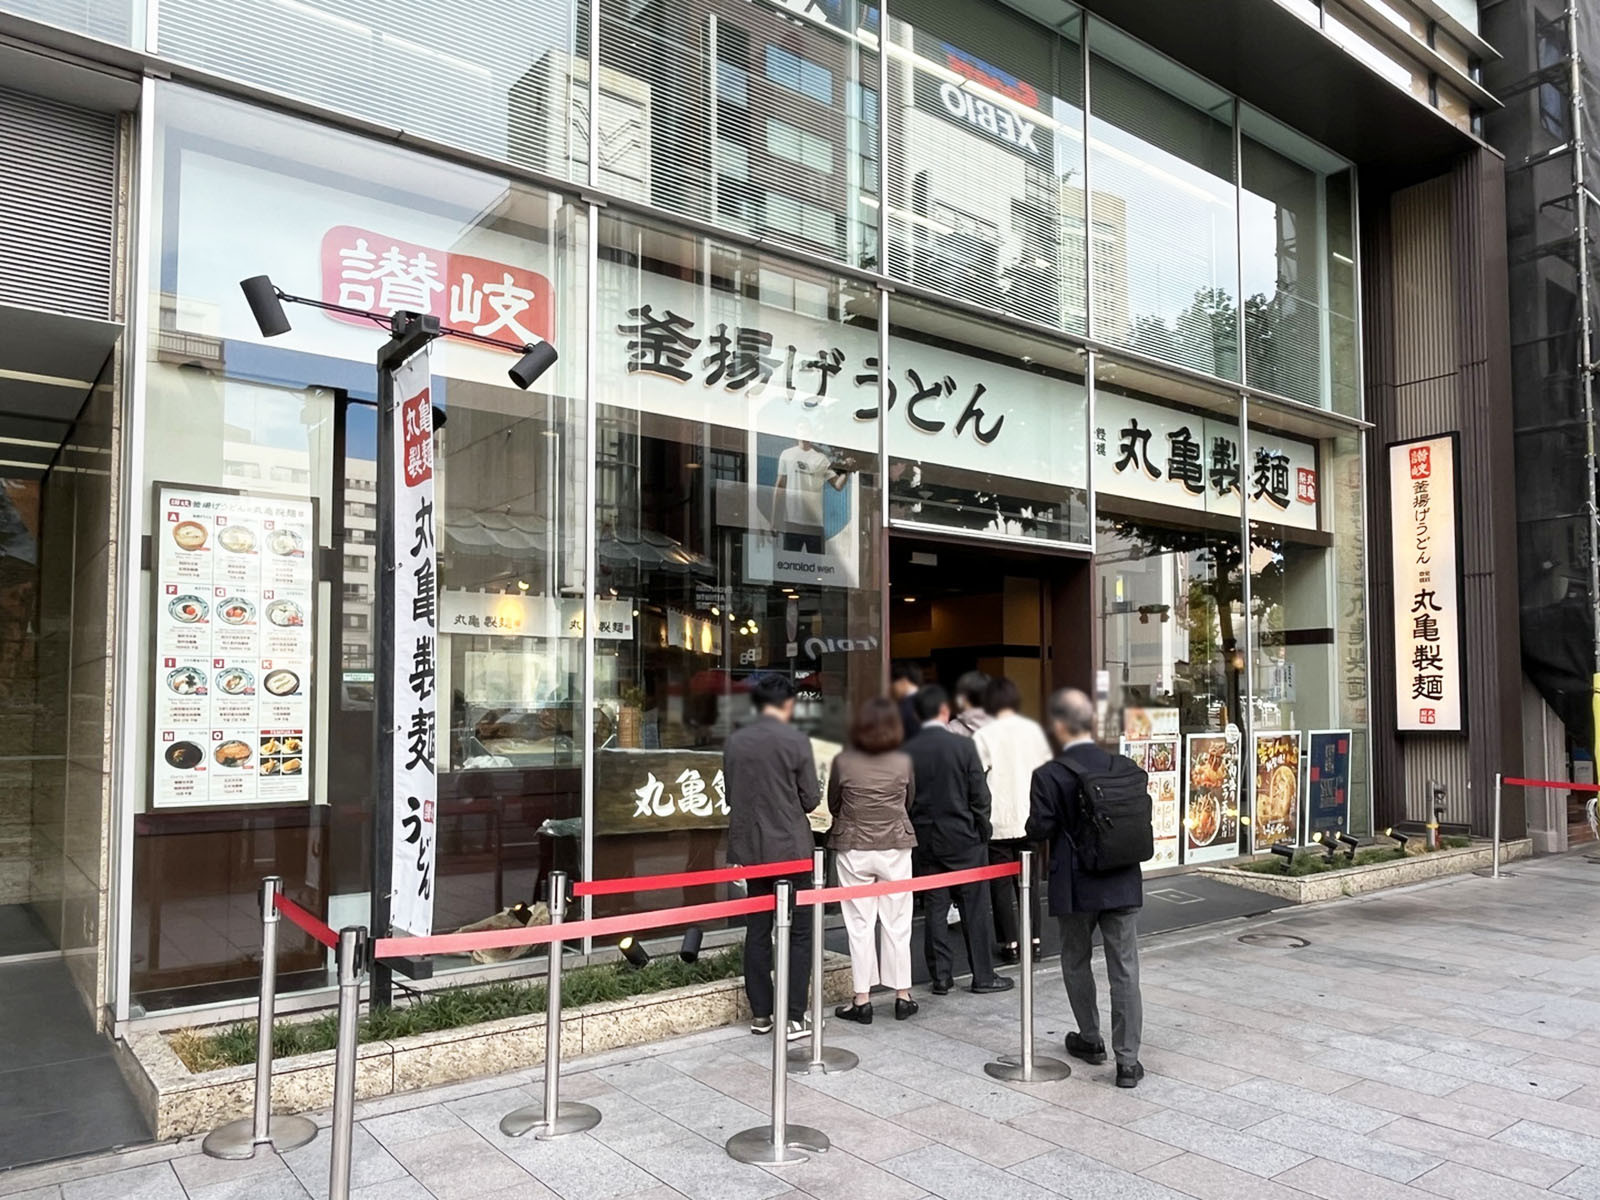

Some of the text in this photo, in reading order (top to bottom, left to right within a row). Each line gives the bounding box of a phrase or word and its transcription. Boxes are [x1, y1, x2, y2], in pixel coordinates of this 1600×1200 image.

[618, 304, 1004, 446] 釜揚げうどん
[1113, 418, 1291, 509] 丸亀製麺
[1413, 480, 1431, 565] 釜揚げうどん
[1411, 588, 1443, 701] 丸亀製麺
[402, 796, 432, 901] うどん
